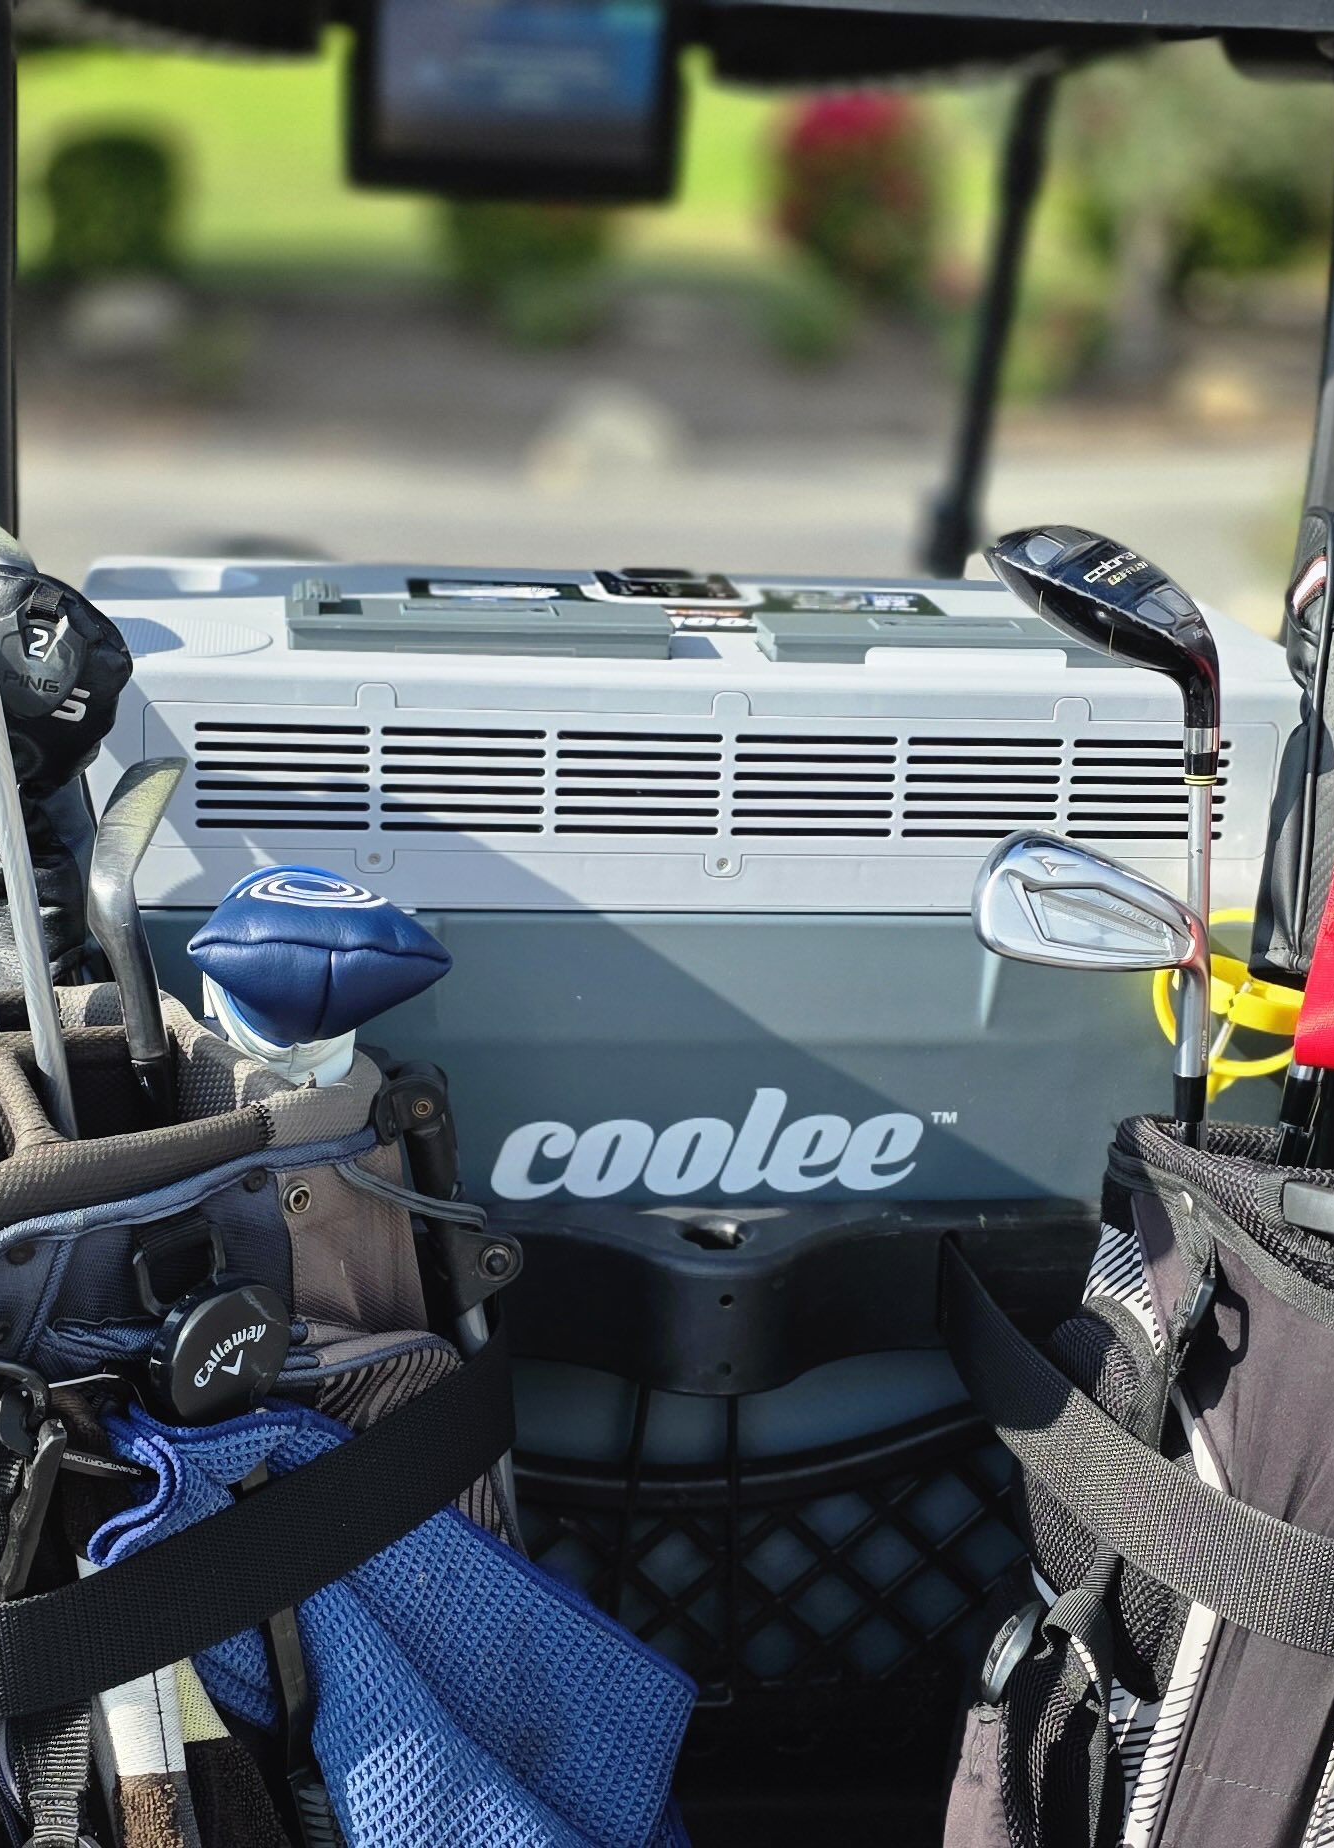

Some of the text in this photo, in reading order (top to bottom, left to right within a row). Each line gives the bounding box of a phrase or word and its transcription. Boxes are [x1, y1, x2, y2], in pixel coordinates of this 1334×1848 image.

[1082, 551, 1138, 584] cobra
[28, 627, 49, 658] 2
[2, 670, 60, 695] PING
[490, 1087, 925, 1201] coolee
[193, 1323, 267, 1389] Callaway
